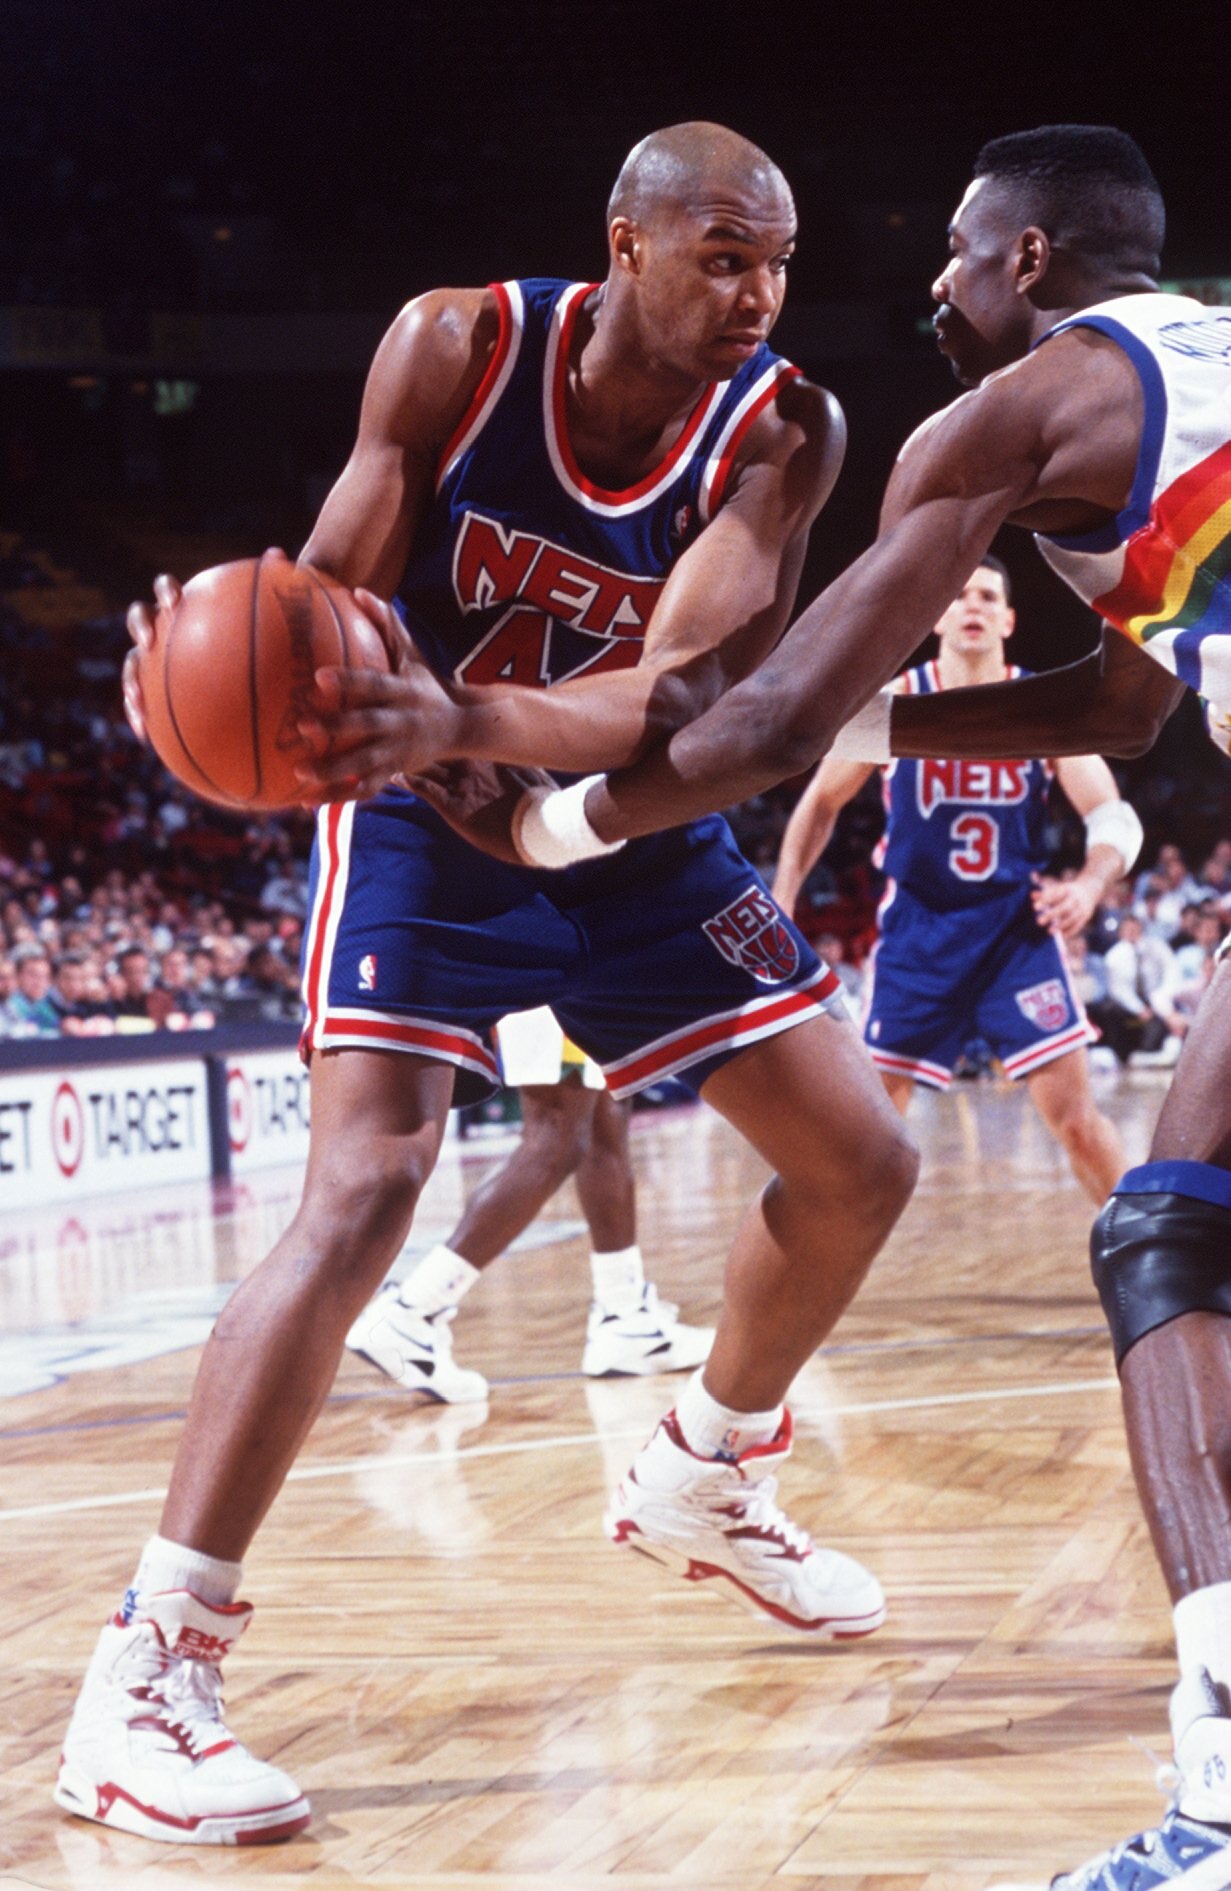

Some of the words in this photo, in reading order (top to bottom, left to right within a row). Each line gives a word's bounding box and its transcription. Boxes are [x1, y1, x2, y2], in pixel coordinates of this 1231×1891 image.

[454, 604, 651, 688] 4
[917, 759, 1032, 819] NETS
[949, 811, 999, 881] 3
[702, 884, 779, 966] NETS
[88, 1085, 196, 1160] TARGET
